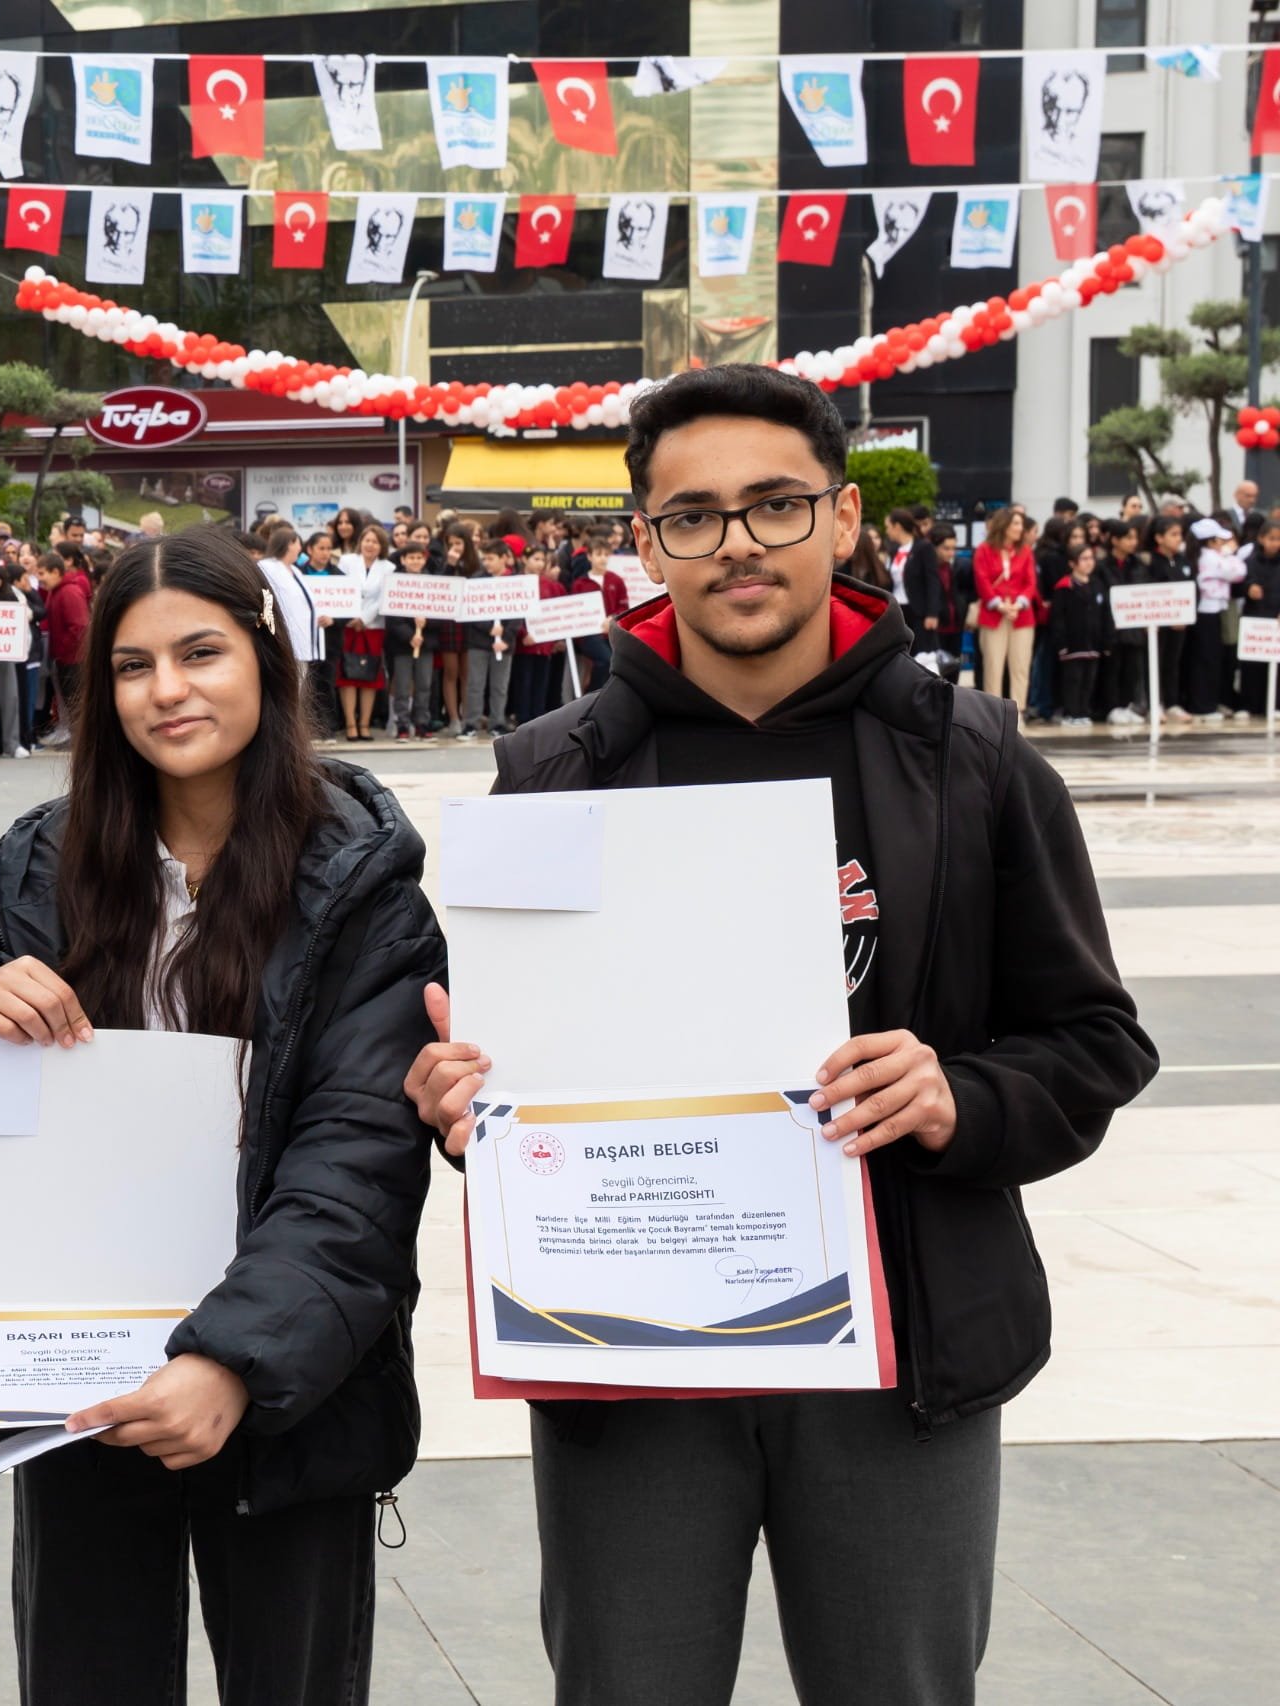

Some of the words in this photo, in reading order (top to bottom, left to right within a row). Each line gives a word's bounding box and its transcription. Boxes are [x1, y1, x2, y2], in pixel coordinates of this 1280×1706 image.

[101, 401, 190, 440] Tuğba
[575, 496, 624, 509] CHICKEN
[396, 580, 450, 590] NARLIDERE
[388, 602, 455, 613] ORTAOKULU
[584, 1144, 645, 1163] BAŞARI
[653, 1137, 719, 1157] BELGESİ
[601, 1176, 635, 1189] Sevgili
[637, 1174, 698, 1188] Öğrencimiz,
[590, 1192, 627, 1202] Behrad
[629, 1189, 715, 1202] PARHIZIGOSHTI
[535, 1215, 569, 1223] Narlıdere
[574, 1215, 588, 1225] İlçe
[594, 1215, 611, 1223] Milli
[617, 1215, 642, 1225] Eğitim
[647, 1214, 689, 1223] Müdürlüğü
[695, 1212, 735, 1221] tarafından
[741, 1210, 786, 1219] düzenlenen
[572, 1226, 596, 1234] Ulusal
[597, 1226, 636, 1236] Egemenlik
[648, 1225, 672, 1235] Çocuk
[709, 1223, 734, 1232] temalı
[735, 1222, 787, 1231] kompozisyon
[538, 1237, 586, 1245] yarışmasında
[588, 1237, 612, 1245] birinci
[615, 1237, 639, 1245] olarak
[646, 1236, 657, 1245] bu
[660, 1236, 688, 1246] belgeyi
[691, 1235, 719, 1244] almaya
[722, 1234, 737, 1242] hak
[740, 1233, 787, 1242] kazanmıştır.
[538, 1245, 582, 1255] Öğrencimizi
[583, 1247, 605, 1255] tebrik
[605, 1247, 622, 1256] eder
[623, 1247, 671, 1257] başarılarının
[671, 1247, 707, 1255] devamını
[707, 1245, 737, 1254] dilerim.
[6, 1332, 63, 1343] BAŞARI
[70, 1329, 131, 1339] BELGESİ
